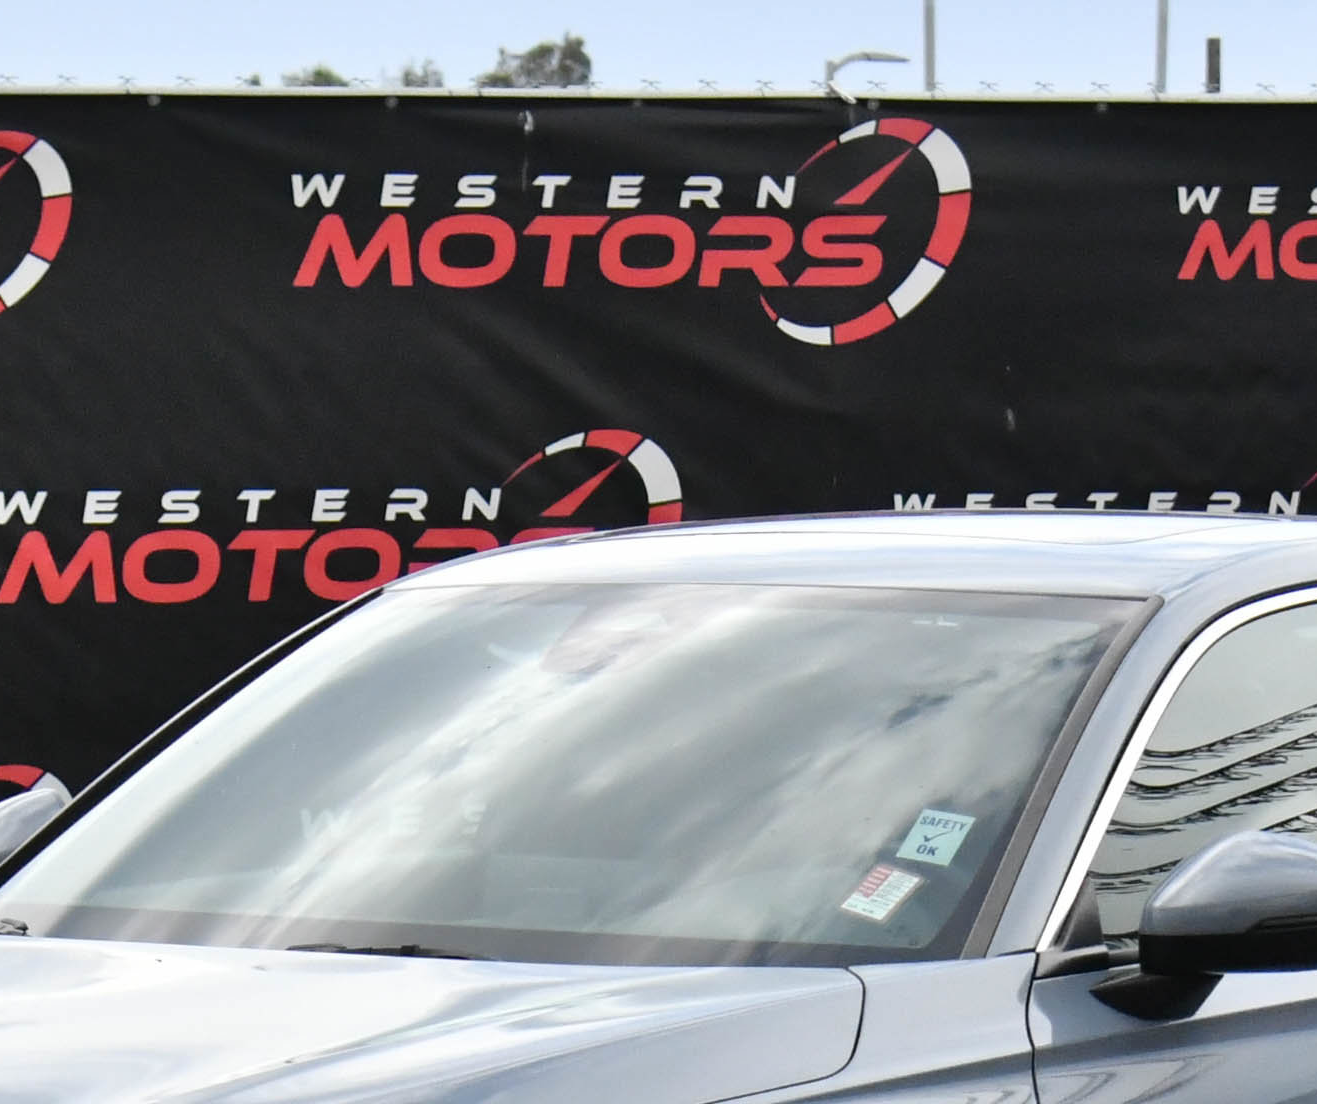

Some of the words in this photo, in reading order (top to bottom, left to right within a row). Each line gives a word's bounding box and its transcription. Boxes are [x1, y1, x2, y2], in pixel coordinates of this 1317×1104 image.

[291, 173, 796, 209] WESTERN
[293, 213, 887, 289] MOTORS
[919, 815, 967, 832] SAFETY
[915, 844, 939, 857] OK
